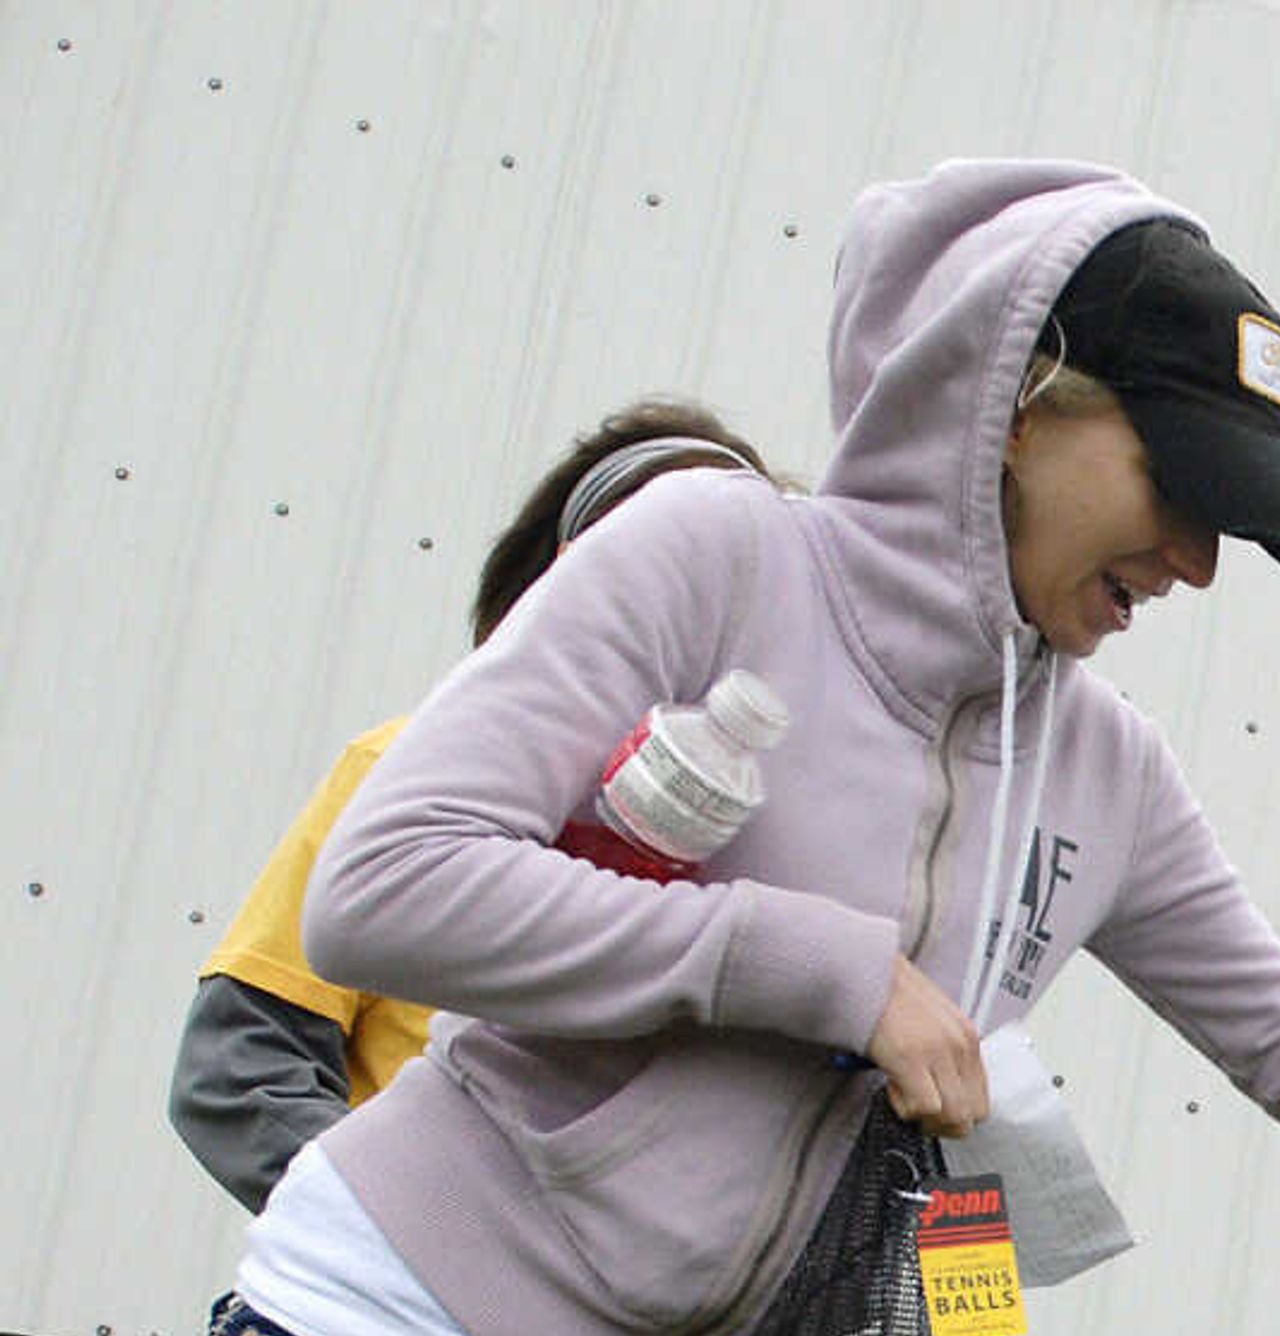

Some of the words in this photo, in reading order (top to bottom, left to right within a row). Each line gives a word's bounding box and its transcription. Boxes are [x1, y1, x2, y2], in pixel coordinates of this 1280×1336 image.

[918, 1189, 1000, 1226] Penn
[932, 1267, 1012, 1291] TENNIS
[935, 1291, 1015, 1315] BALLS
